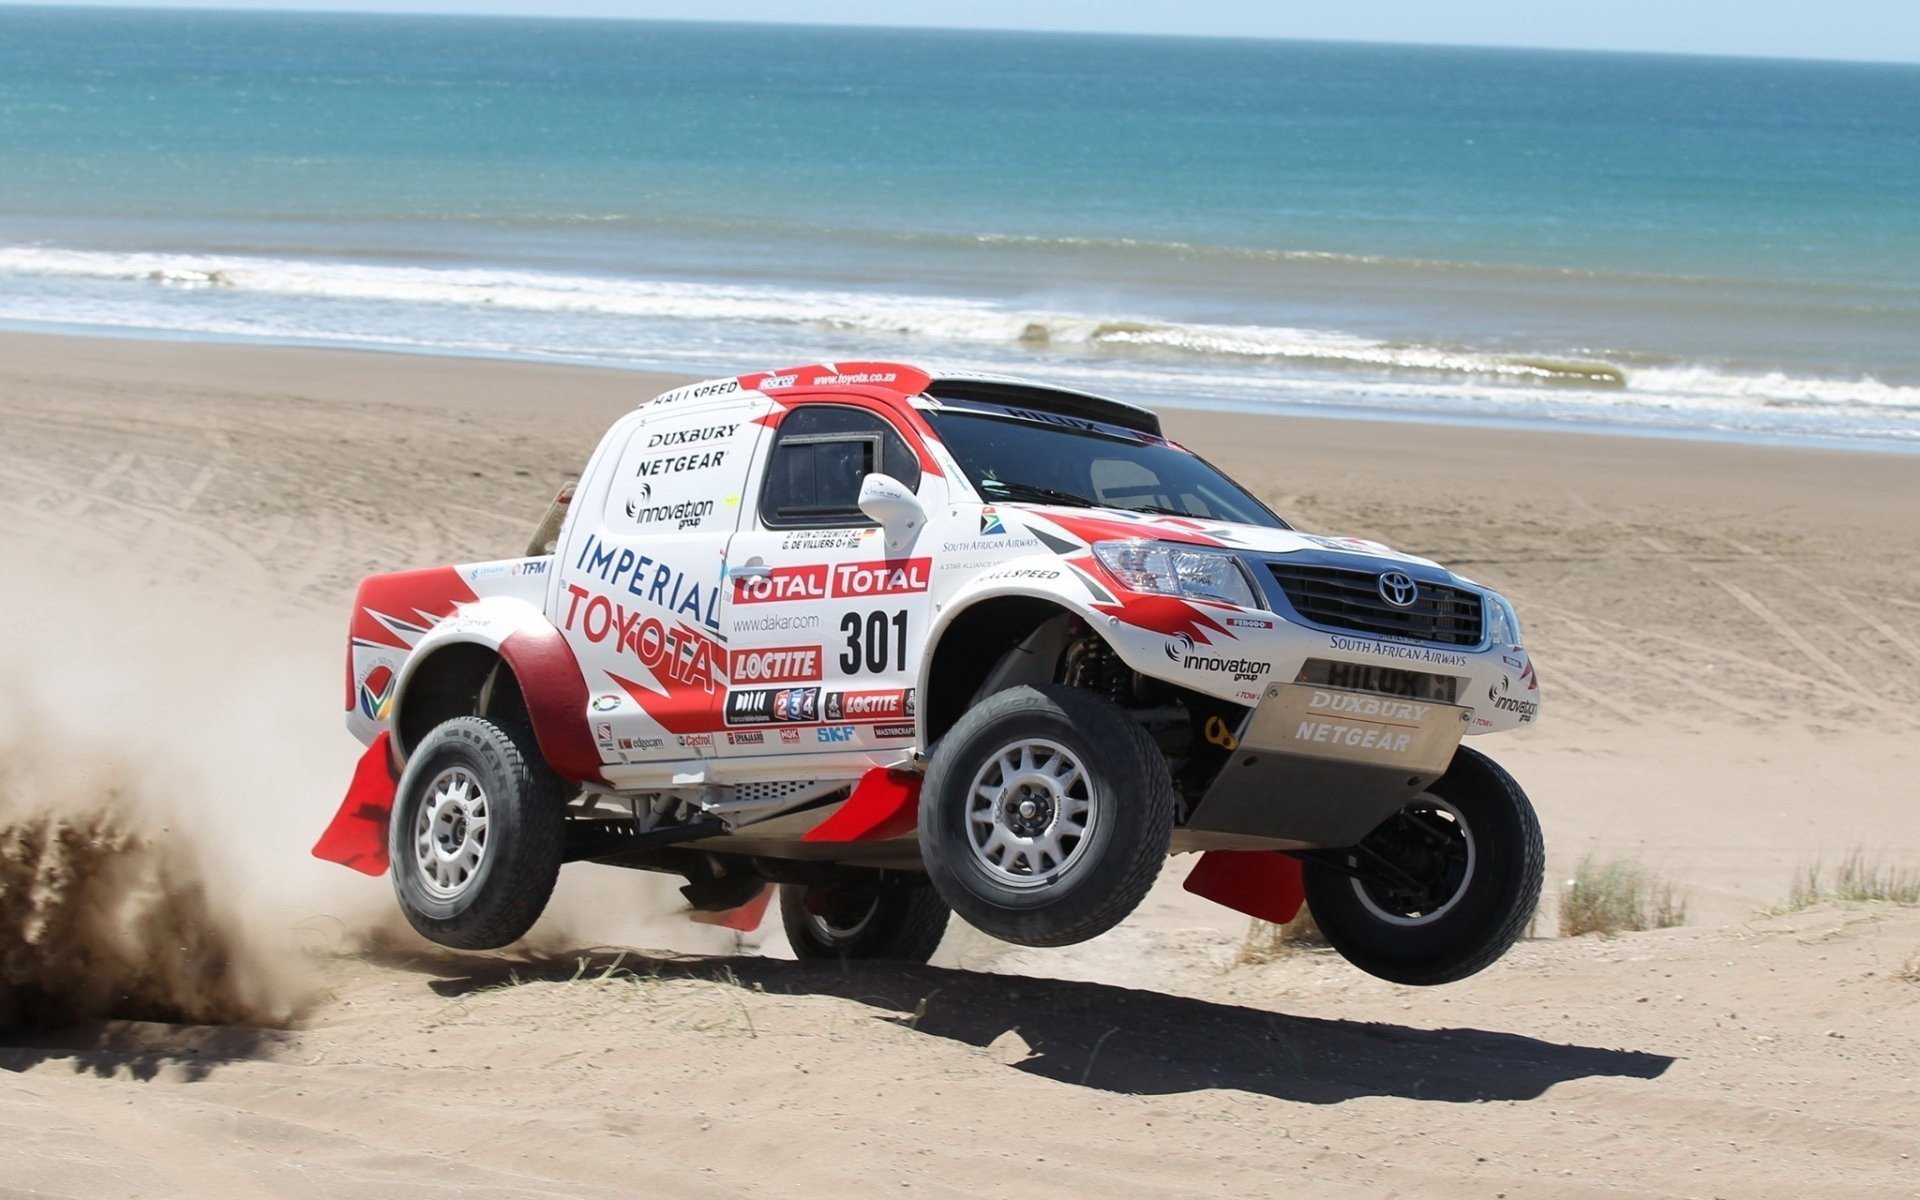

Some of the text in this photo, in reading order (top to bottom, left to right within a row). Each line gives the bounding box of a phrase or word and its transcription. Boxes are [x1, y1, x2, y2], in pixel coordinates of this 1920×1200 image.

[813, 373, 897, 386] www.toyota.co.za
[1004, 407, 1105, 433] HILUX
[647, 423, 741, 448] DUXBURY
[636, 451, 726, 477] NETGEAR
[636, 500, 714, 524] innovation
[678, 518, 701, 530] group
[791, 540, 802, 550] DE
[803, 539, 834, 549] VILLIERS
[942, 538, 1039, 553] SOUTH AFRICAN AIRWAYS
[522, 560, 548, 575] TFM
[946, 562, 961, 570] STAR
[576, 534, 720, 630] IMPERIAL
[837, 565, 927, 594] TOTAL
[565, 583, 716, 695] TOYOTA
[733, 609, 908, 675] www.dakar.com 301
[1329, 635, 1371, 653] SOUTH
[1372, 642, 1420, 660] AFRICAN
[1421, 649, 1467, 667] AIRWAYS
[734, 650, 817, 680] LOCTITE
[1184, 655, 1271, 675] innovation
[1233, 673, 1259, 682] group
[1328, 661, 1418, 697] HILUX
[846, 694, 900, 713] LOCTITE
[1309, 691, 1431, 721] DUXBURY
[1494, 696, 1538, 715] innovation
[632, 736, 664, 751] edgecam
[686, 734, 711, 747] Castrol
[780, 728, 800, 740] NGK
[816, 726, 856, 743] SKF
[1295, 721, 1412, 752] NETGEAR
